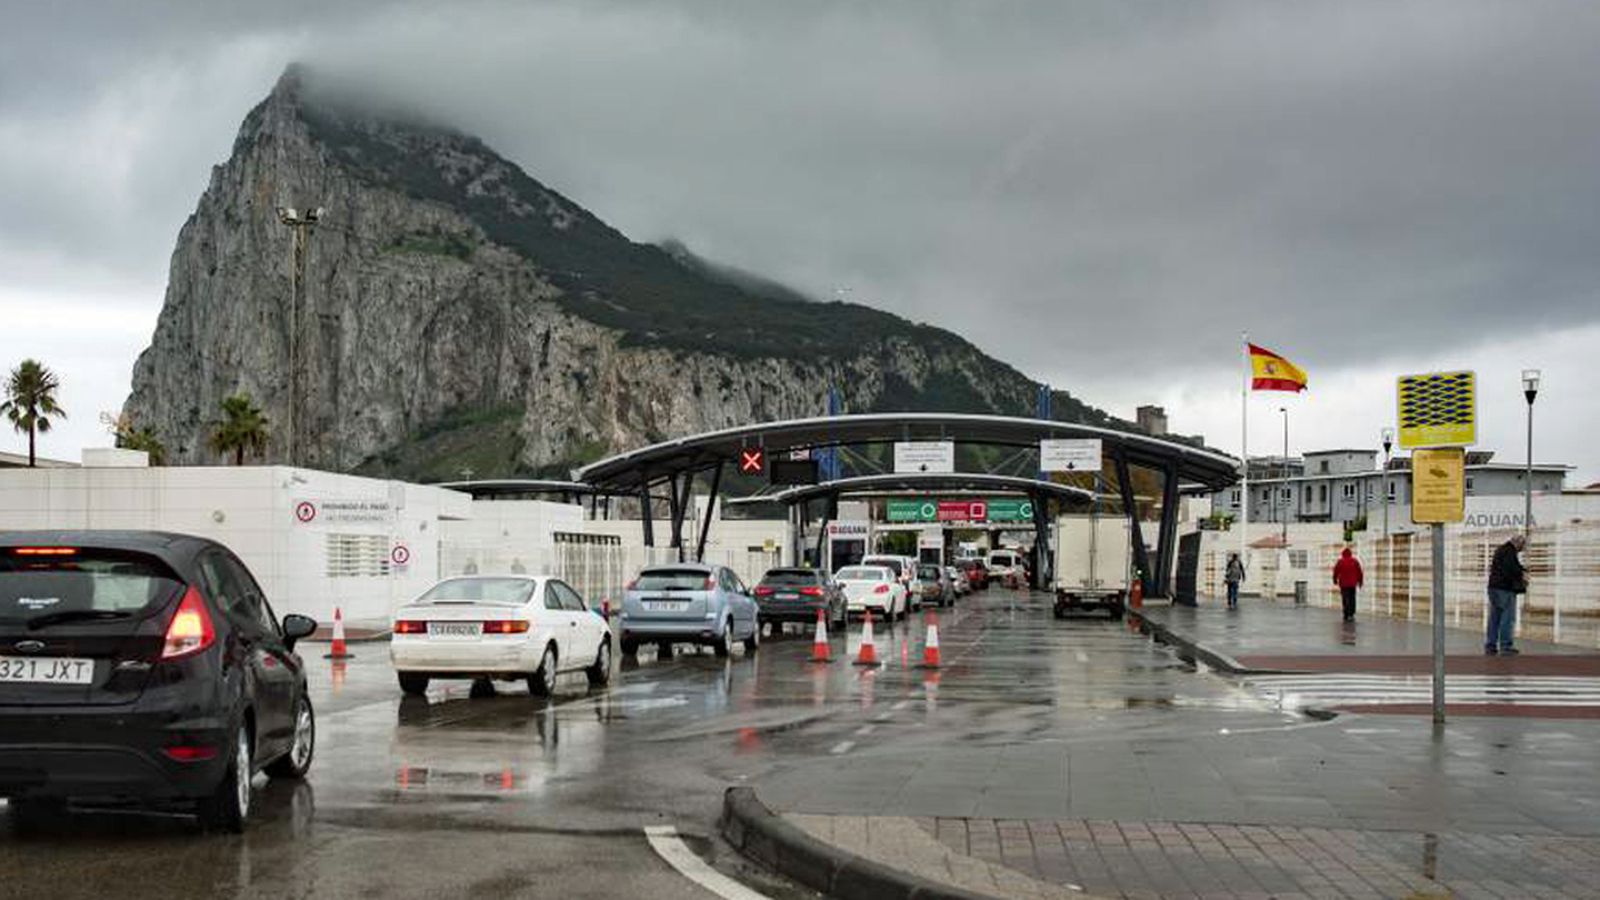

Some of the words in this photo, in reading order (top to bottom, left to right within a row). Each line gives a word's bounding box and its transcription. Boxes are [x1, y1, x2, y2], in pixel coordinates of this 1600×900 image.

[1465, 514, 1536, 528] ADUANA
[0, 660, 36, 679] 321
[45, 660, 86, 680] JXT
